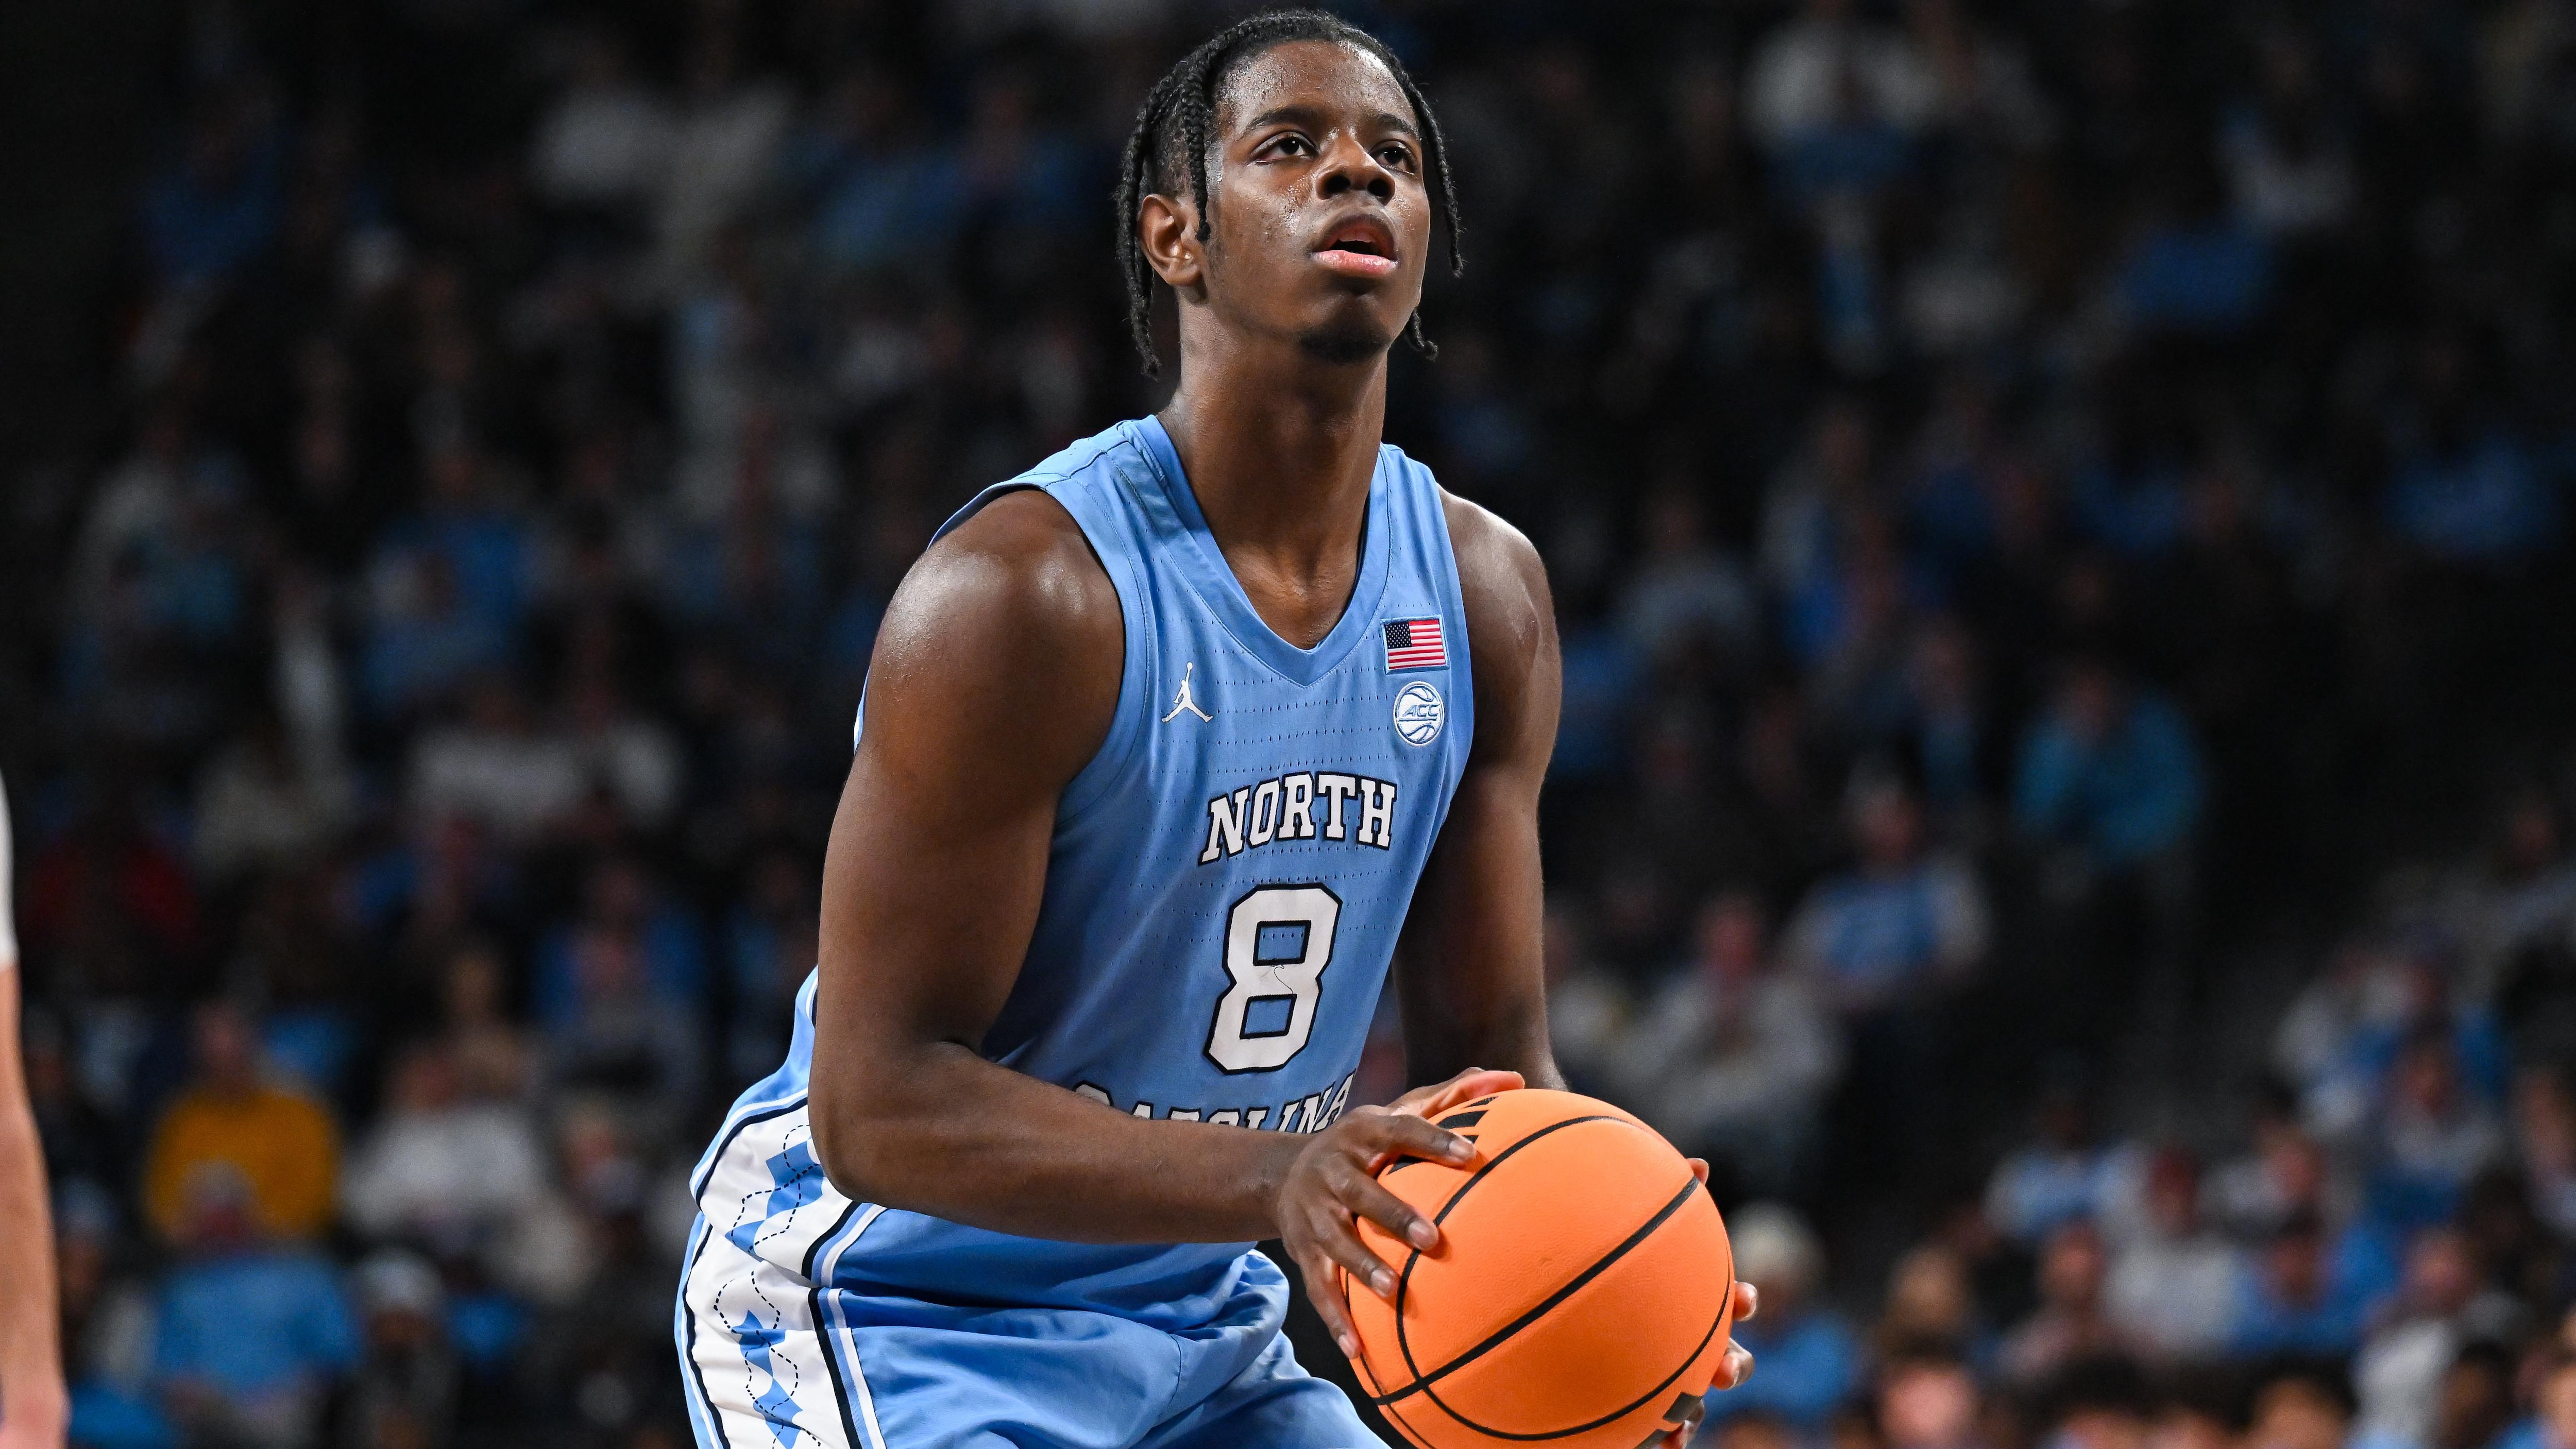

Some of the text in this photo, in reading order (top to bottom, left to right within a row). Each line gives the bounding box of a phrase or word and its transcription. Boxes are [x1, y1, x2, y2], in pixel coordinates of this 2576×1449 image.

[1402, 704, 1440, 717] ACC
[1198, 771, 1397, 865] NORTH
[1204, 882, 1343, 1074] 8
